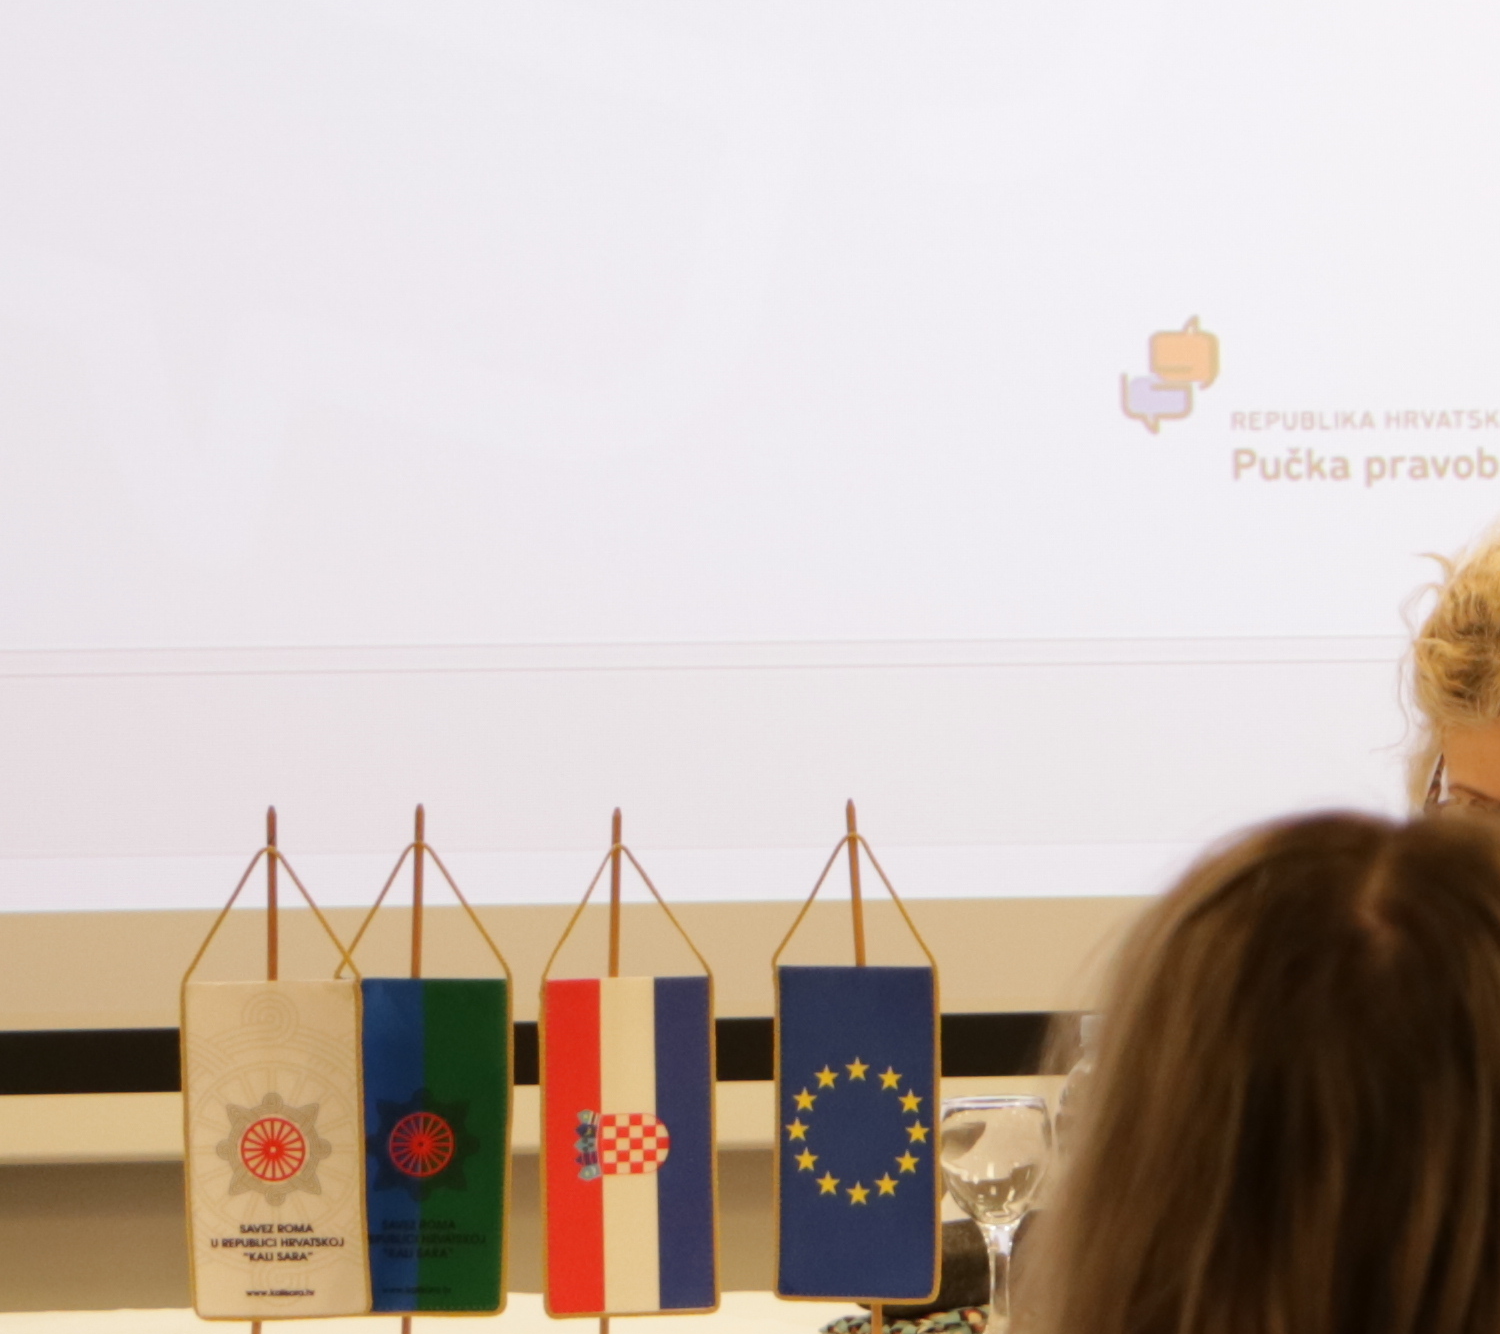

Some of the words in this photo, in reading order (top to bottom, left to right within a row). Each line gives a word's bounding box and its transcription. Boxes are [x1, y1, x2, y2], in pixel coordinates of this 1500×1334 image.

[1232, 412, 1374, 430] REPUBLIKA
[1234, 449, 1350, 480] Pučka
[239, 1224, 274, 1234] SAVEZ
[277, 1224, 313, 1233] ROMA
[211, 1239, 218, 1248] U
[221, 1238, 277, 1248] REPUBLICI
[281, 1238, 344, 1247] HRVATSKOJ
